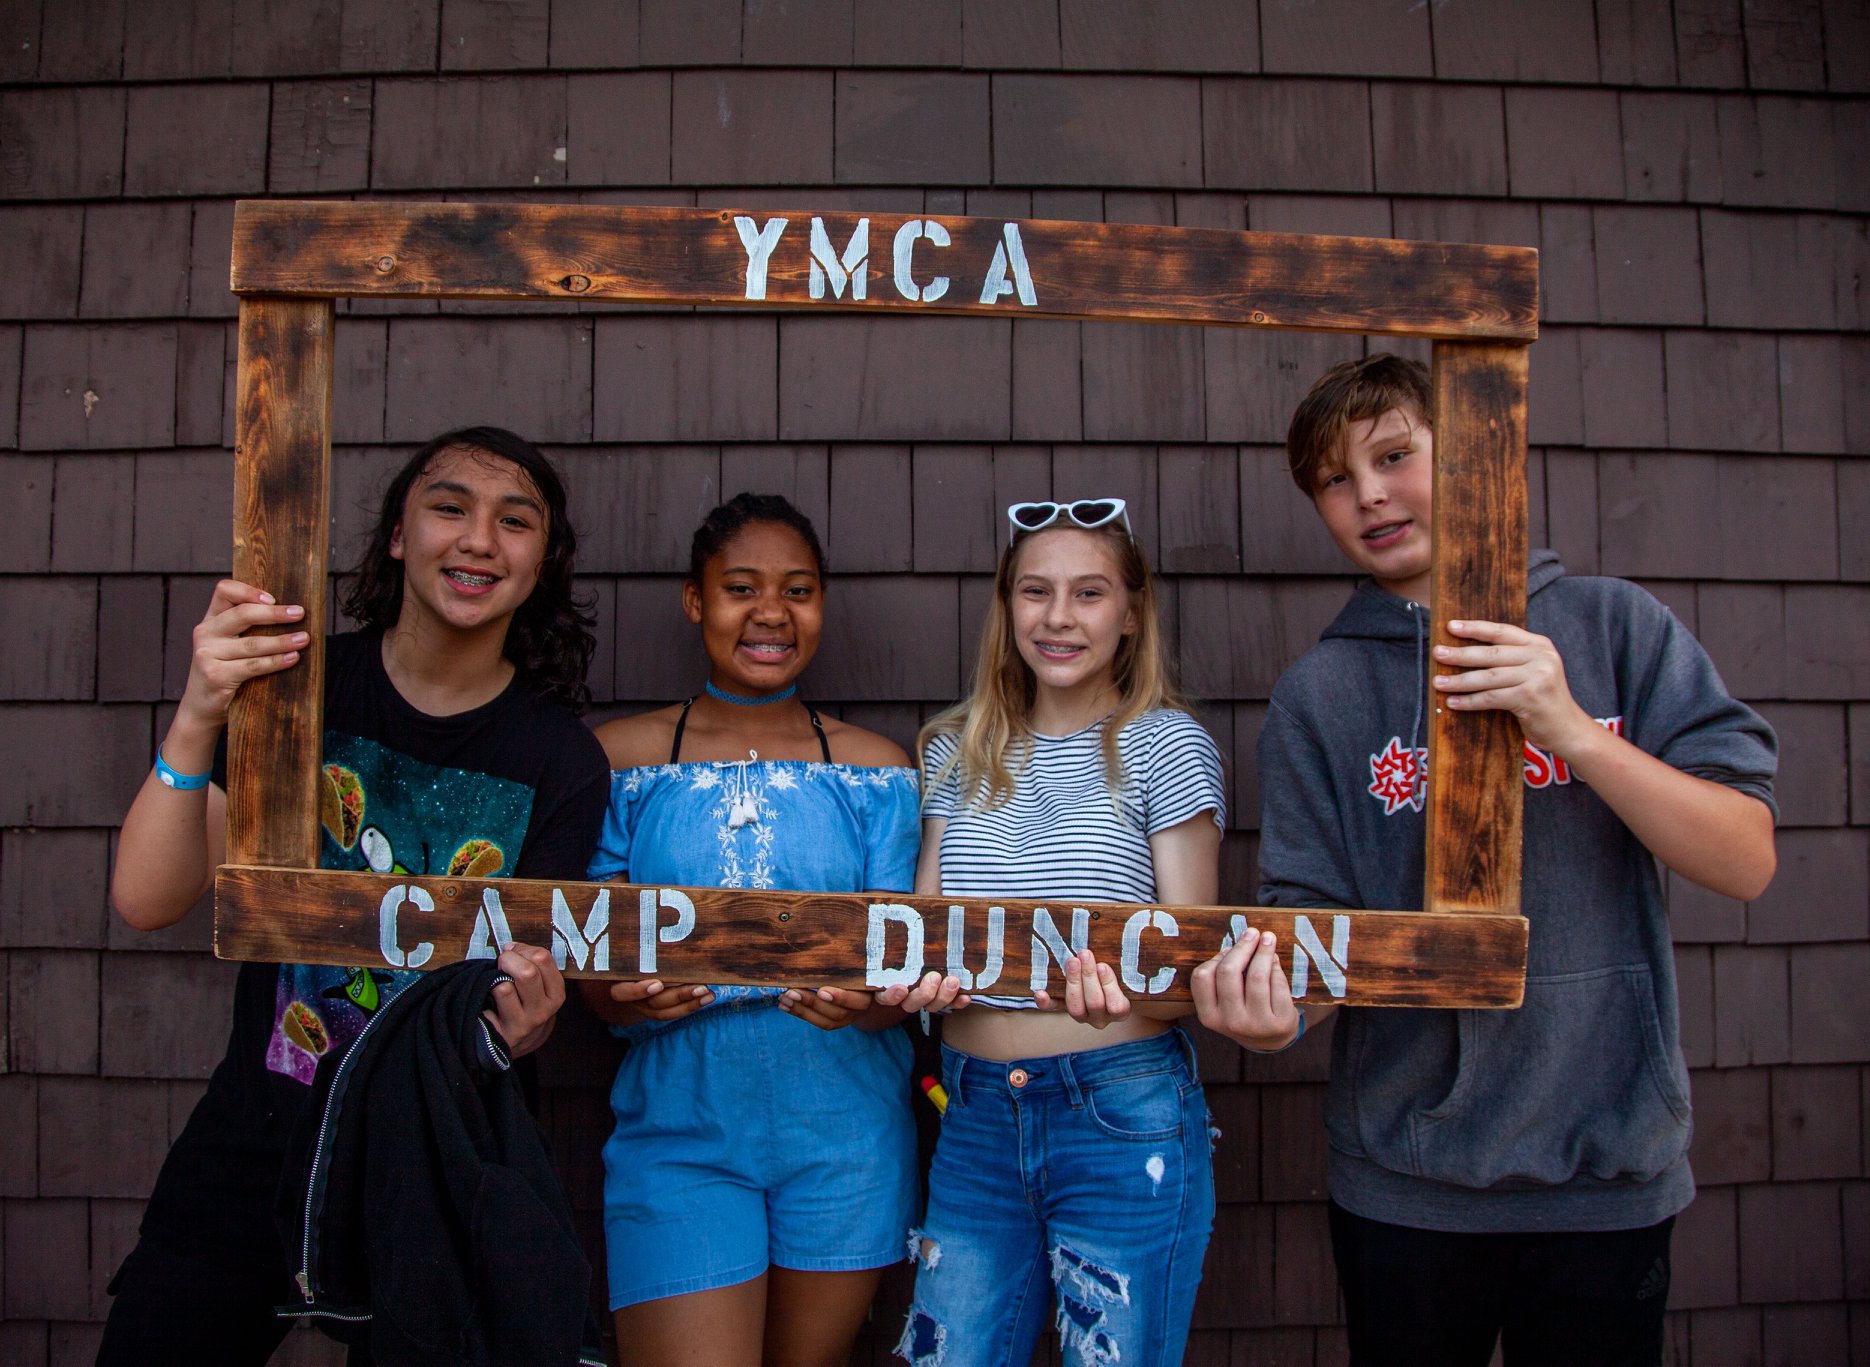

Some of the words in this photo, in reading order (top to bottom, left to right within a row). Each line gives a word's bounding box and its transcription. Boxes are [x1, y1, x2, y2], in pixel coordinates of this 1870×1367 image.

[733, 216, 1038, 306] YMCA
[379, 884, 696, 974] CAMP
[866, 903, 1351, 999] DUNCN
